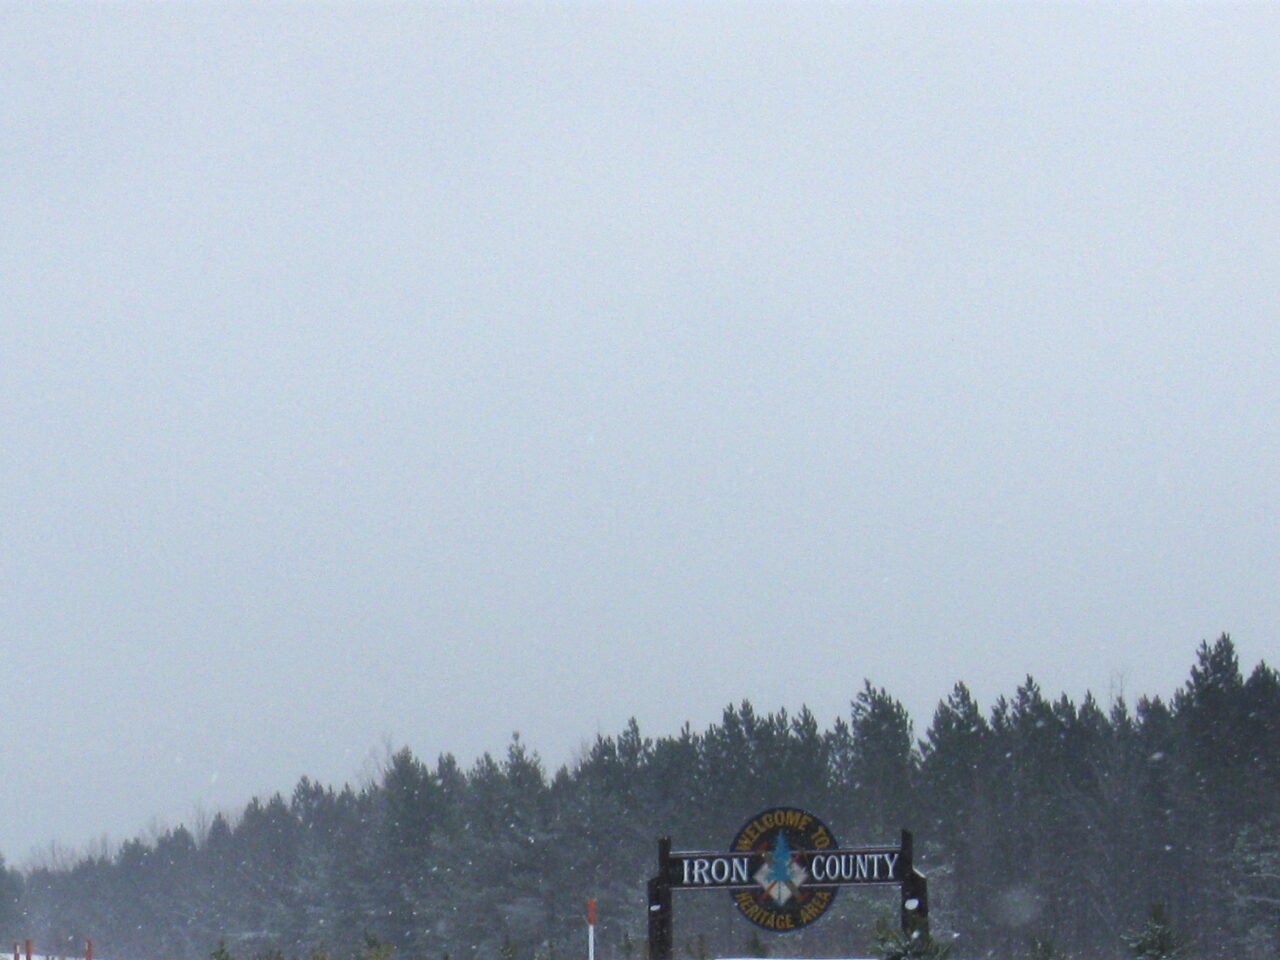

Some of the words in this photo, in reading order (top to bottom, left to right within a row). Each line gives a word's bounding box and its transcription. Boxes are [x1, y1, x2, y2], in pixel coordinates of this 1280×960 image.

[736, 810, 813, 850] WELCOME
[811, 825, 831, 849] TO
[682, 857, 750, 885] IRON
[811, 853, 899, 881] COUNTY
[735, 892, 795, 929] HERITAGE
[800, 892, 832, 924] AREA
